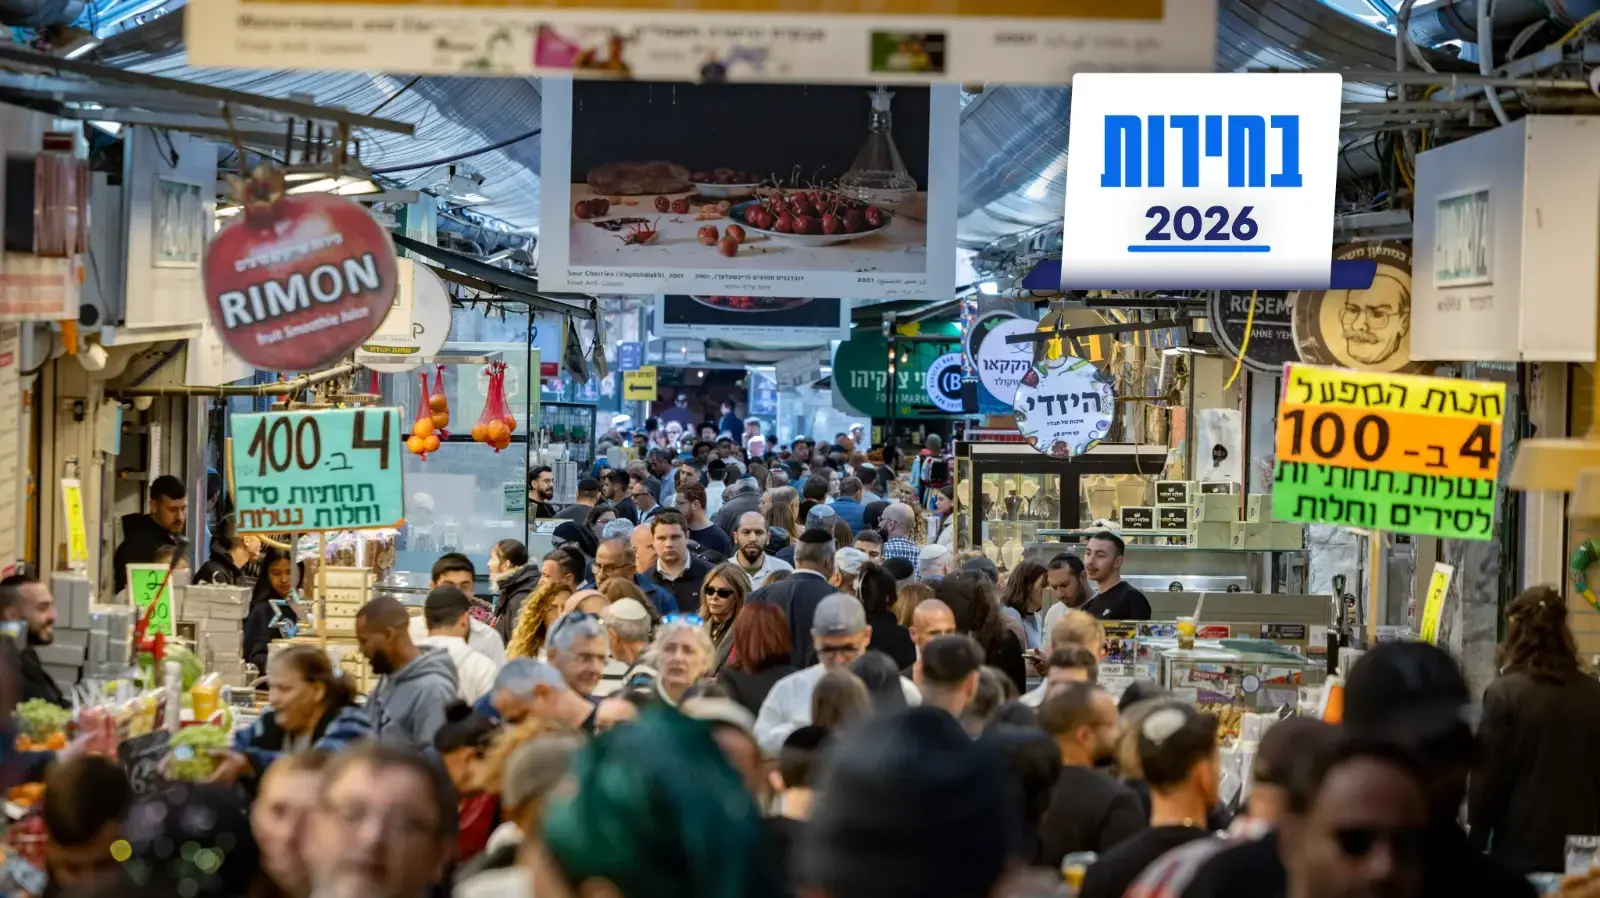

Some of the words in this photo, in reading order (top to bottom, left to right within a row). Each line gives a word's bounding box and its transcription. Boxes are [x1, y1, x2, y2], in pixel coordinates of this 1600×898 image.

[585, 270, 614, 278] Cherries
[219, 254, 379, 328] RIMON
[1230, 295, 1292, 315] ROSEM
[284, 315, 340, 339] Smoothie
[340, 306, 370, 324] Juice
[1246, 329, 1273, 339] AHNE
[1276, 330, 1293, 340] YEH
[983, 359, 1031, 374] הקקאו
[850, 370, 909, 392] צקיהו
[1298, 378, 1408, 407] המפעל
[1027, 392, 1101, 416] היזדי
[1420, 387, 1502, 417] חנות
[248, 415, 321, 477] 100
[352, 410, 391, 470] 4
[1283, 409, 1390, 462] 100
[1459, 424, 1496, 469] 4
[237, 485, 278, 504] סיר
[288, 483, 375, 504] תחתיות
[237, 507, 304, 528] נטלות
[314, 504, 381, 527] וחלות
[1293, 493, 1376, 526] וחלות
[1390, 503, 1491, 534] לסירים
